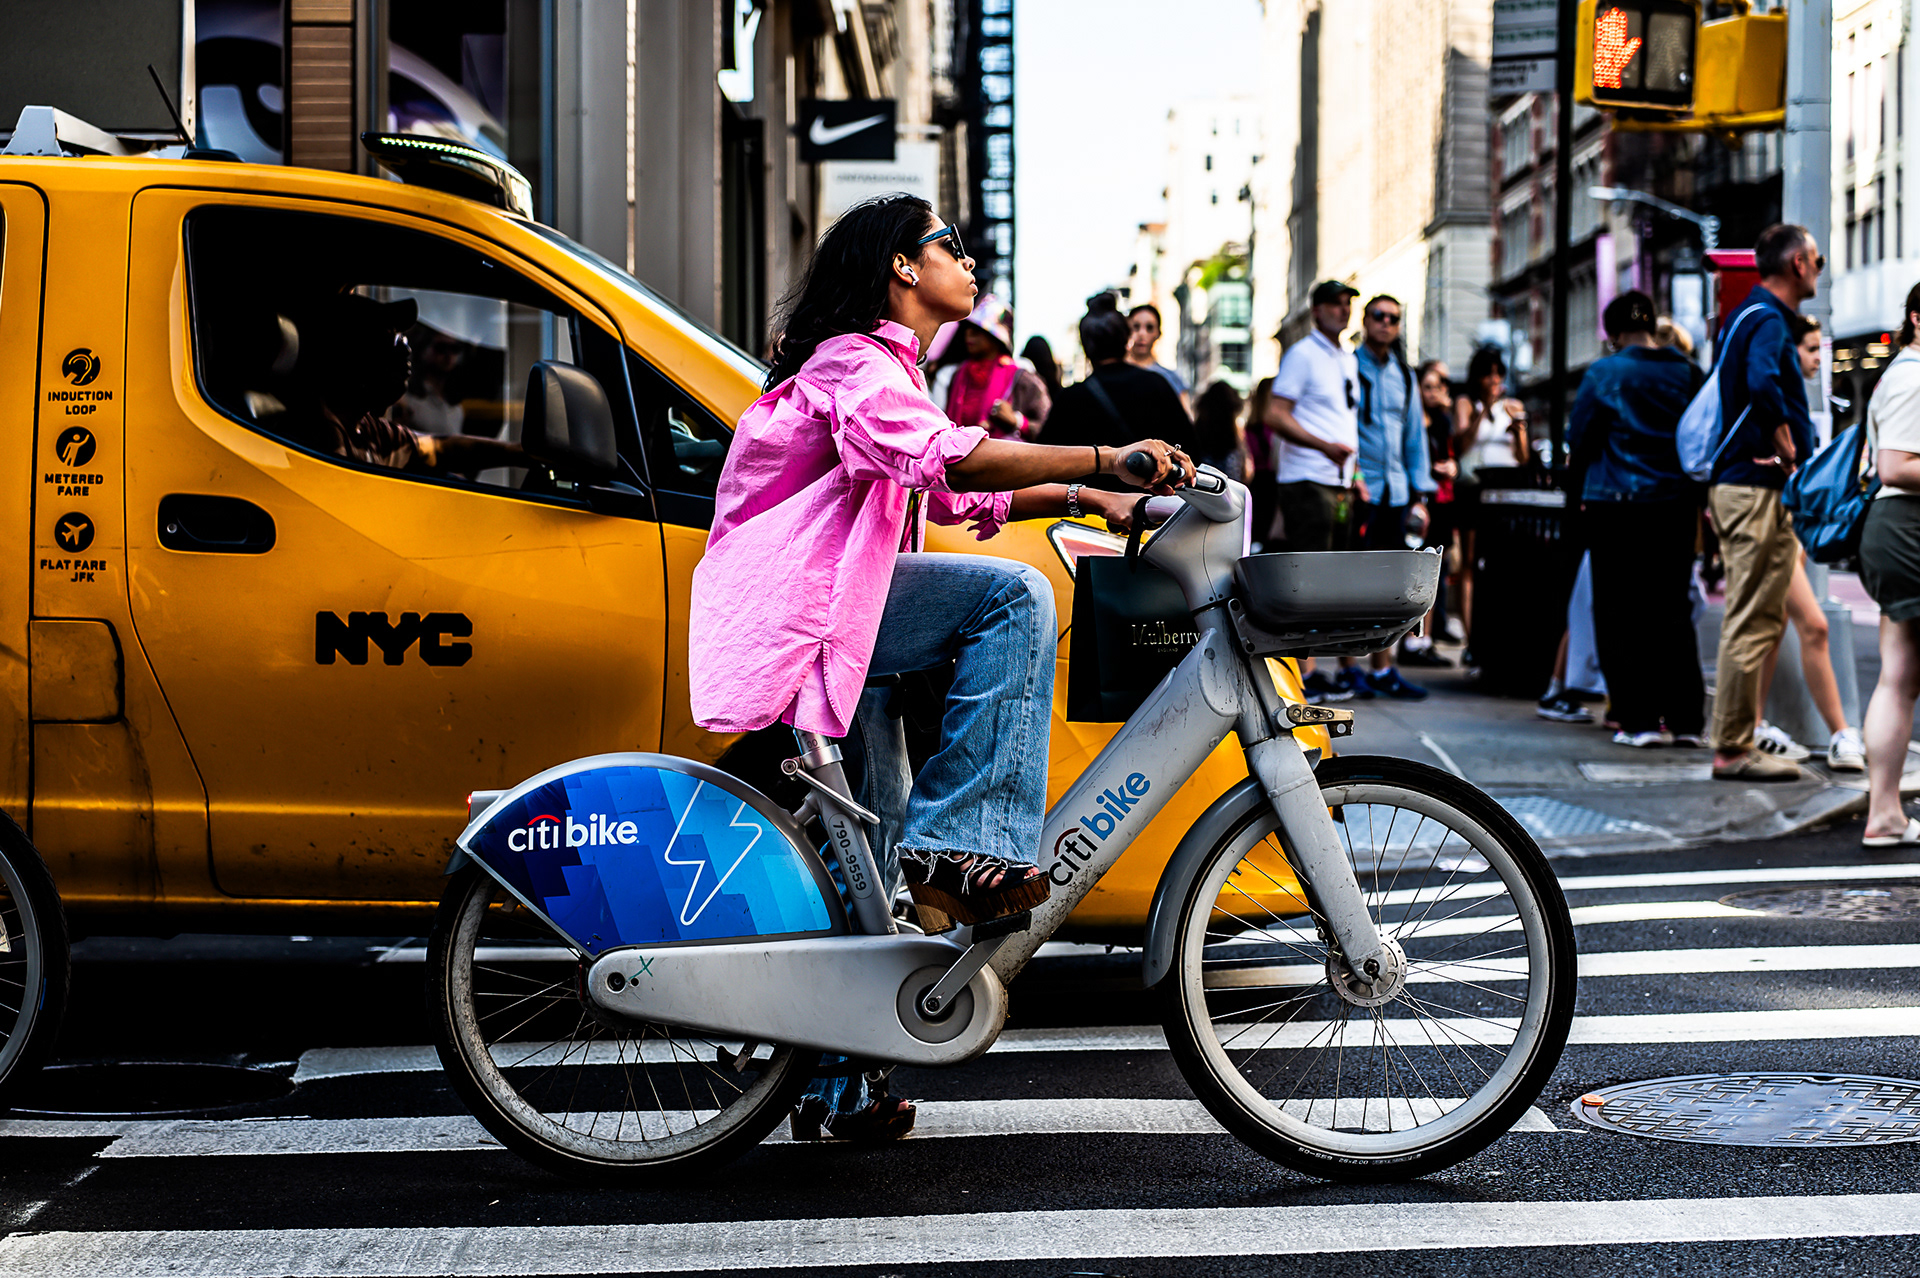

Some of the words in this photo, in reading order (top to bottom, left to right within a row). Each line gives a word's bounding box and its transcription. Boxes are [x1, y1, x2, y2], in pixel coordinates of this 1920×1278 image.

[48, 391, 113, 401] INDUCTION
[66, 405, 97, 415] LOOP
[45, 473, 104, 485] METERED
[58, 486, 89, 496] FARE
[40, 559, 71, 570] FLAT
[74, 560, 107, 571] FARE
[71, 572, 95, 582] JFK
[315, 611, 473, 667] NYC
[1131, 621, 1201, 649] Mulberry
[508, 815, 561, 852] citi
[566, 813, 639, 848] bike
[1049, 828, 1098, 886] citi
[1080, 772, 1151, 841] bike
[832, 820, 867, 892] 790-9559
